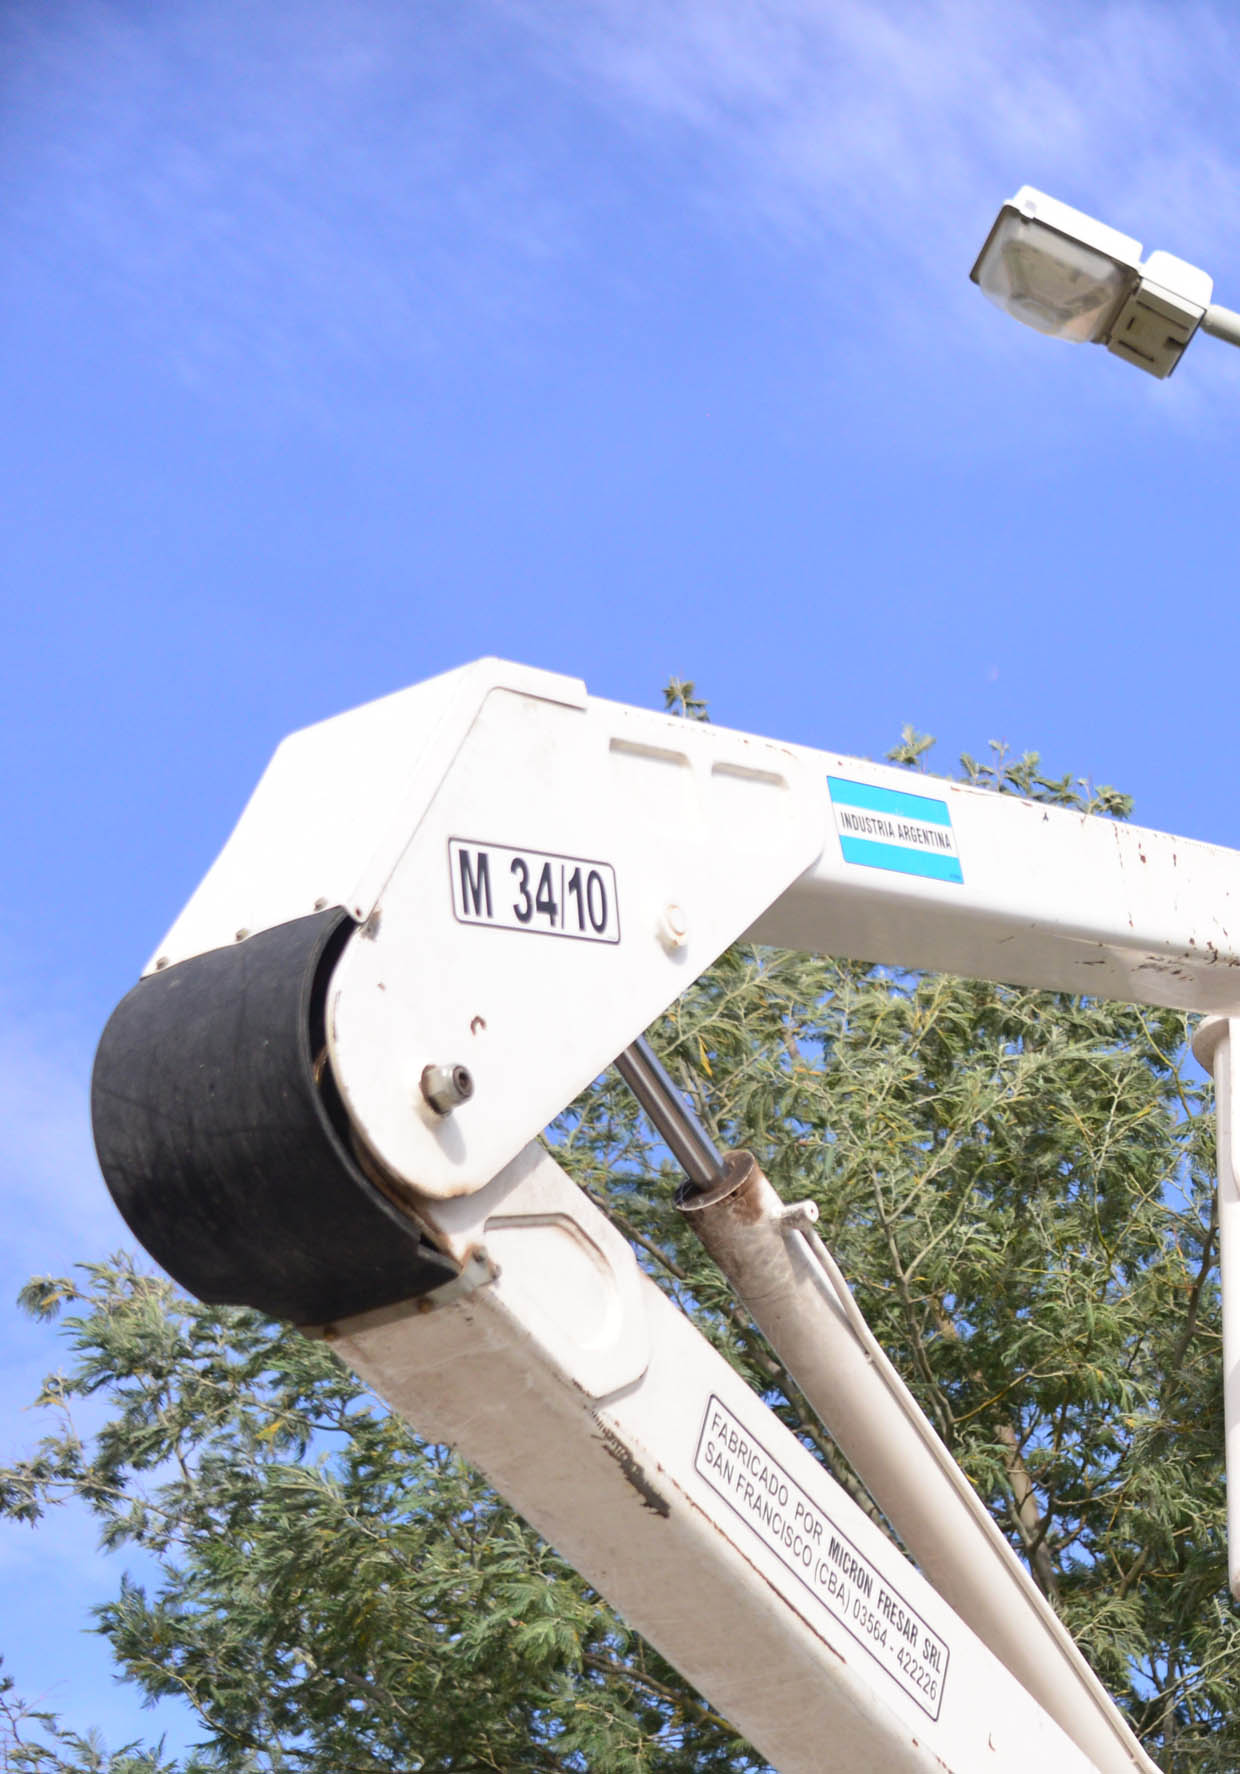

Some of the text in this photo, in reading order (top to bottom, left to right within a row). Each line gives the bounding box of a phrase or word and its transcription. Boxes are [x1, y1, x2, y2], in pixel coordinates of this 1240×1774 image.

[459, 849, 607, 934] M 34/10
[840, 812, 952, 850] INDUSTRIA ARGENTINA
[705, 1441, 733, 1485] SAN
[736, 1473, 812, 1568] FRANCISCO
[814, 1558, 850, 1614] (CBA)
[853, 1598, 887, 1649] 03564
[896, 1645, 938, 1701] 422226
[711, 1412, 941, 1674] FABRICADO POR MICRON FRESAR SRL
